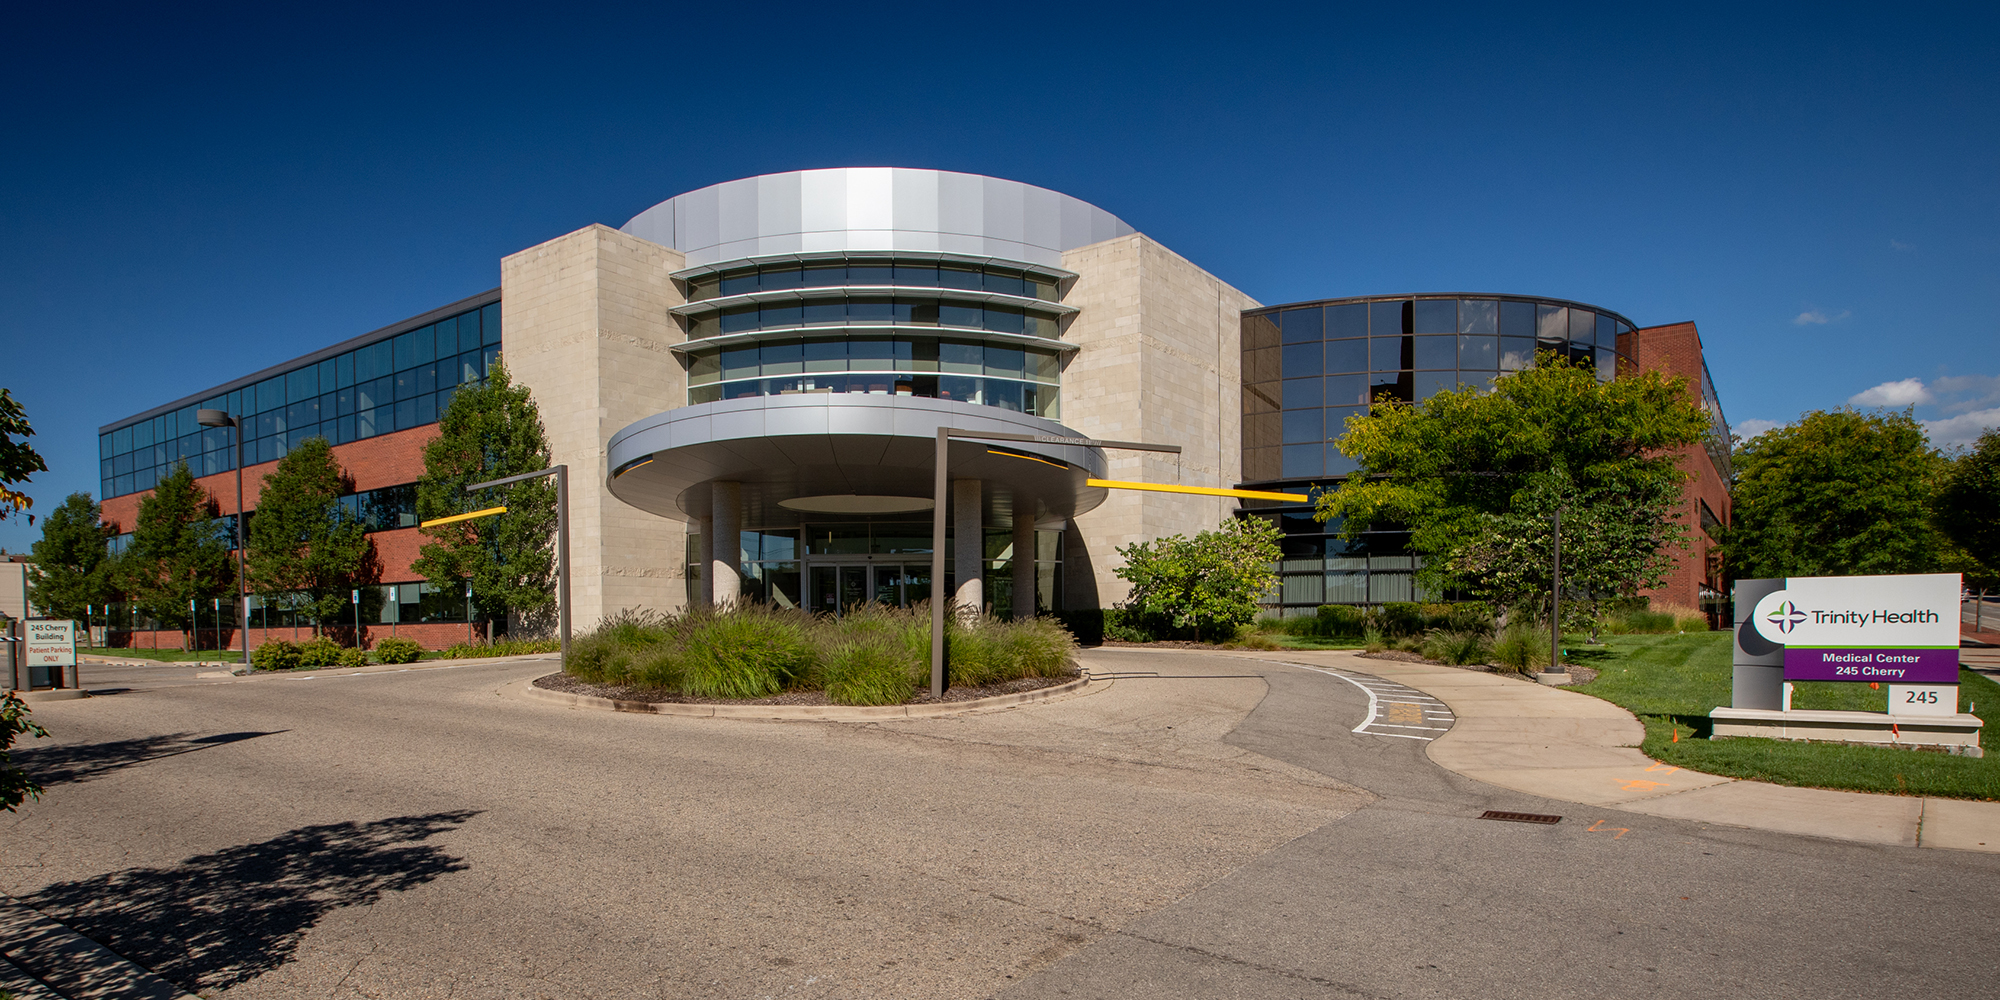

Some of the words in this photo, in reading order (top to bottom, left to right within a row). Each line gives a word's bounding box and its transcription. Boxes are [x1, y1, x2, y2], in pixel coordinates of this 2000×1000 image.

[1042, 436, 1084, 444] CLEARANCE
[1811, 609, 1869, 628] Trinity
[1872, 609, 1939, 624] Health
[45, 624, 68, 632] Cherry
[35, 633, 64, 641] Building
[1822, 653, 1873, 663] Medical
[1875, 653, 1920, 663] Center
[1835, 666, 1858, 675] 245
[1862, 666, 1905, 678] Cherry
[1906, 690, 1938, 704] 245
